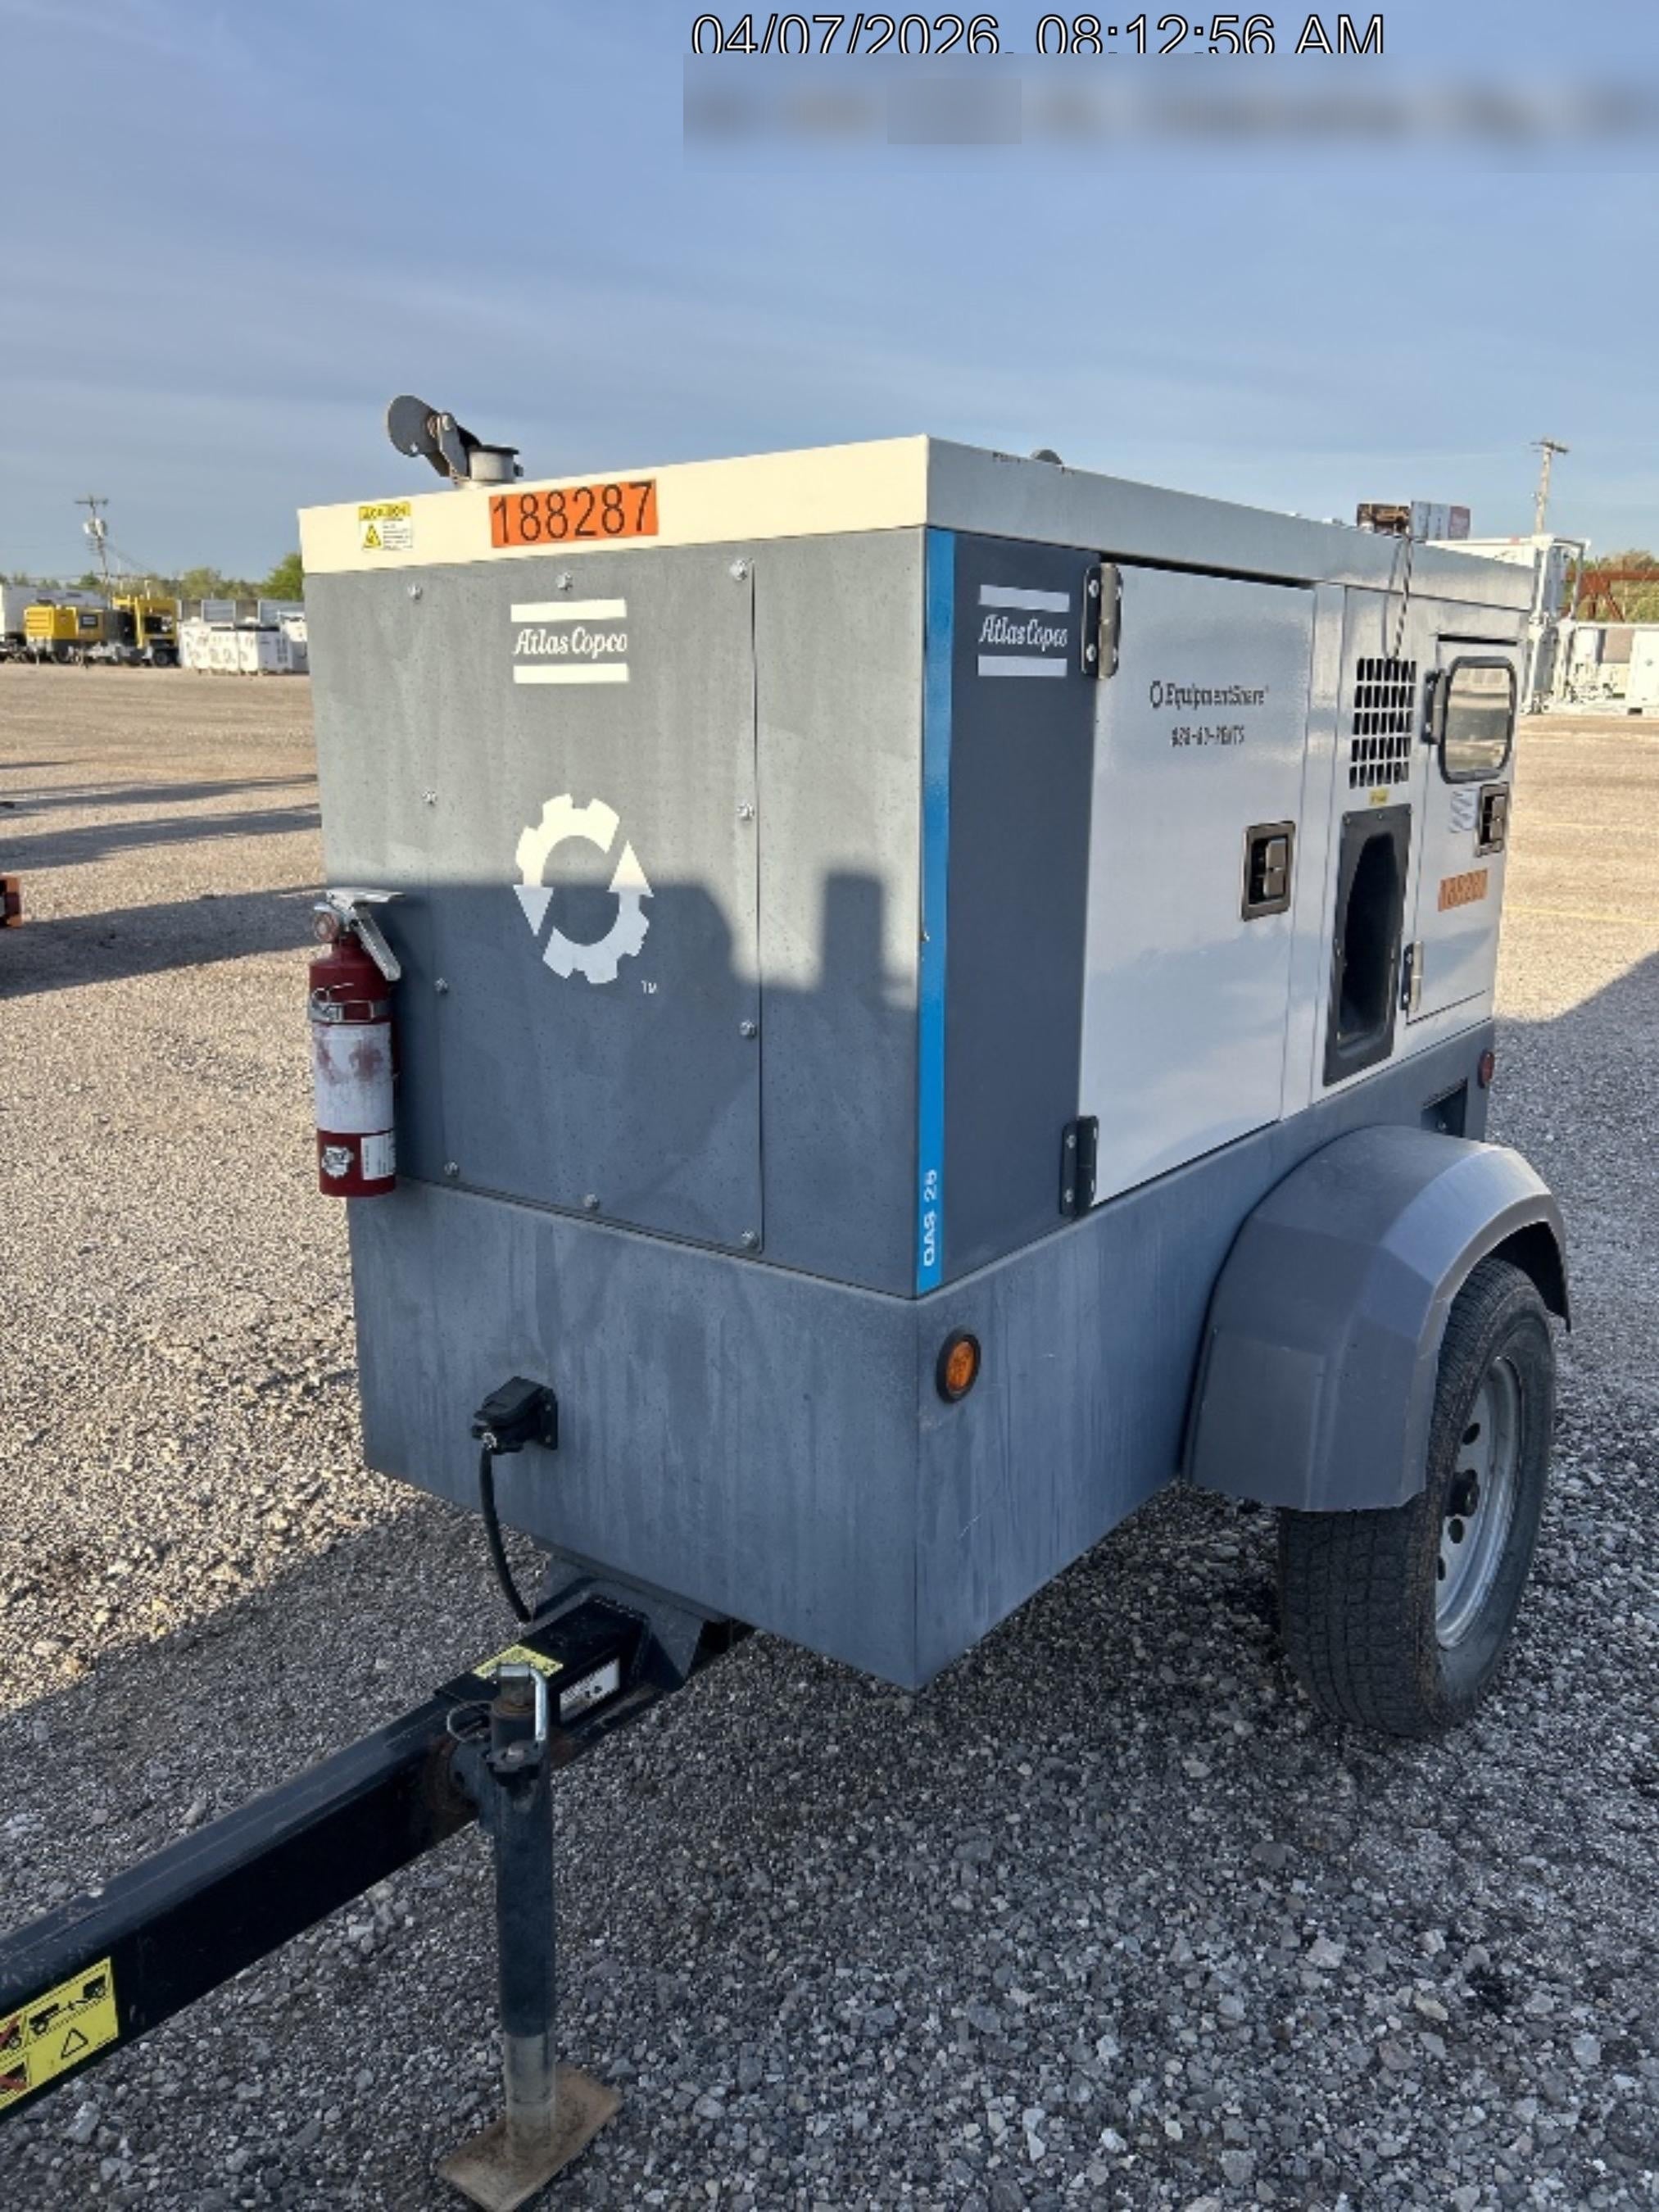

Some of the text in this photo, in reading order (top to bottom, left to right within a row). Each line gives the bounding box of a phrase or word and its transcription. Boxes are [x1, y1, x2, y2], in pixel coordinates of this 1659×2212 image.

[493, 482, 652, 543] 188287
[512, 627, 628, 659] Atlas Copco
[979, 614, 1067, 651] Atlas Copco
[923, 1210, 936, 1267] QAS
